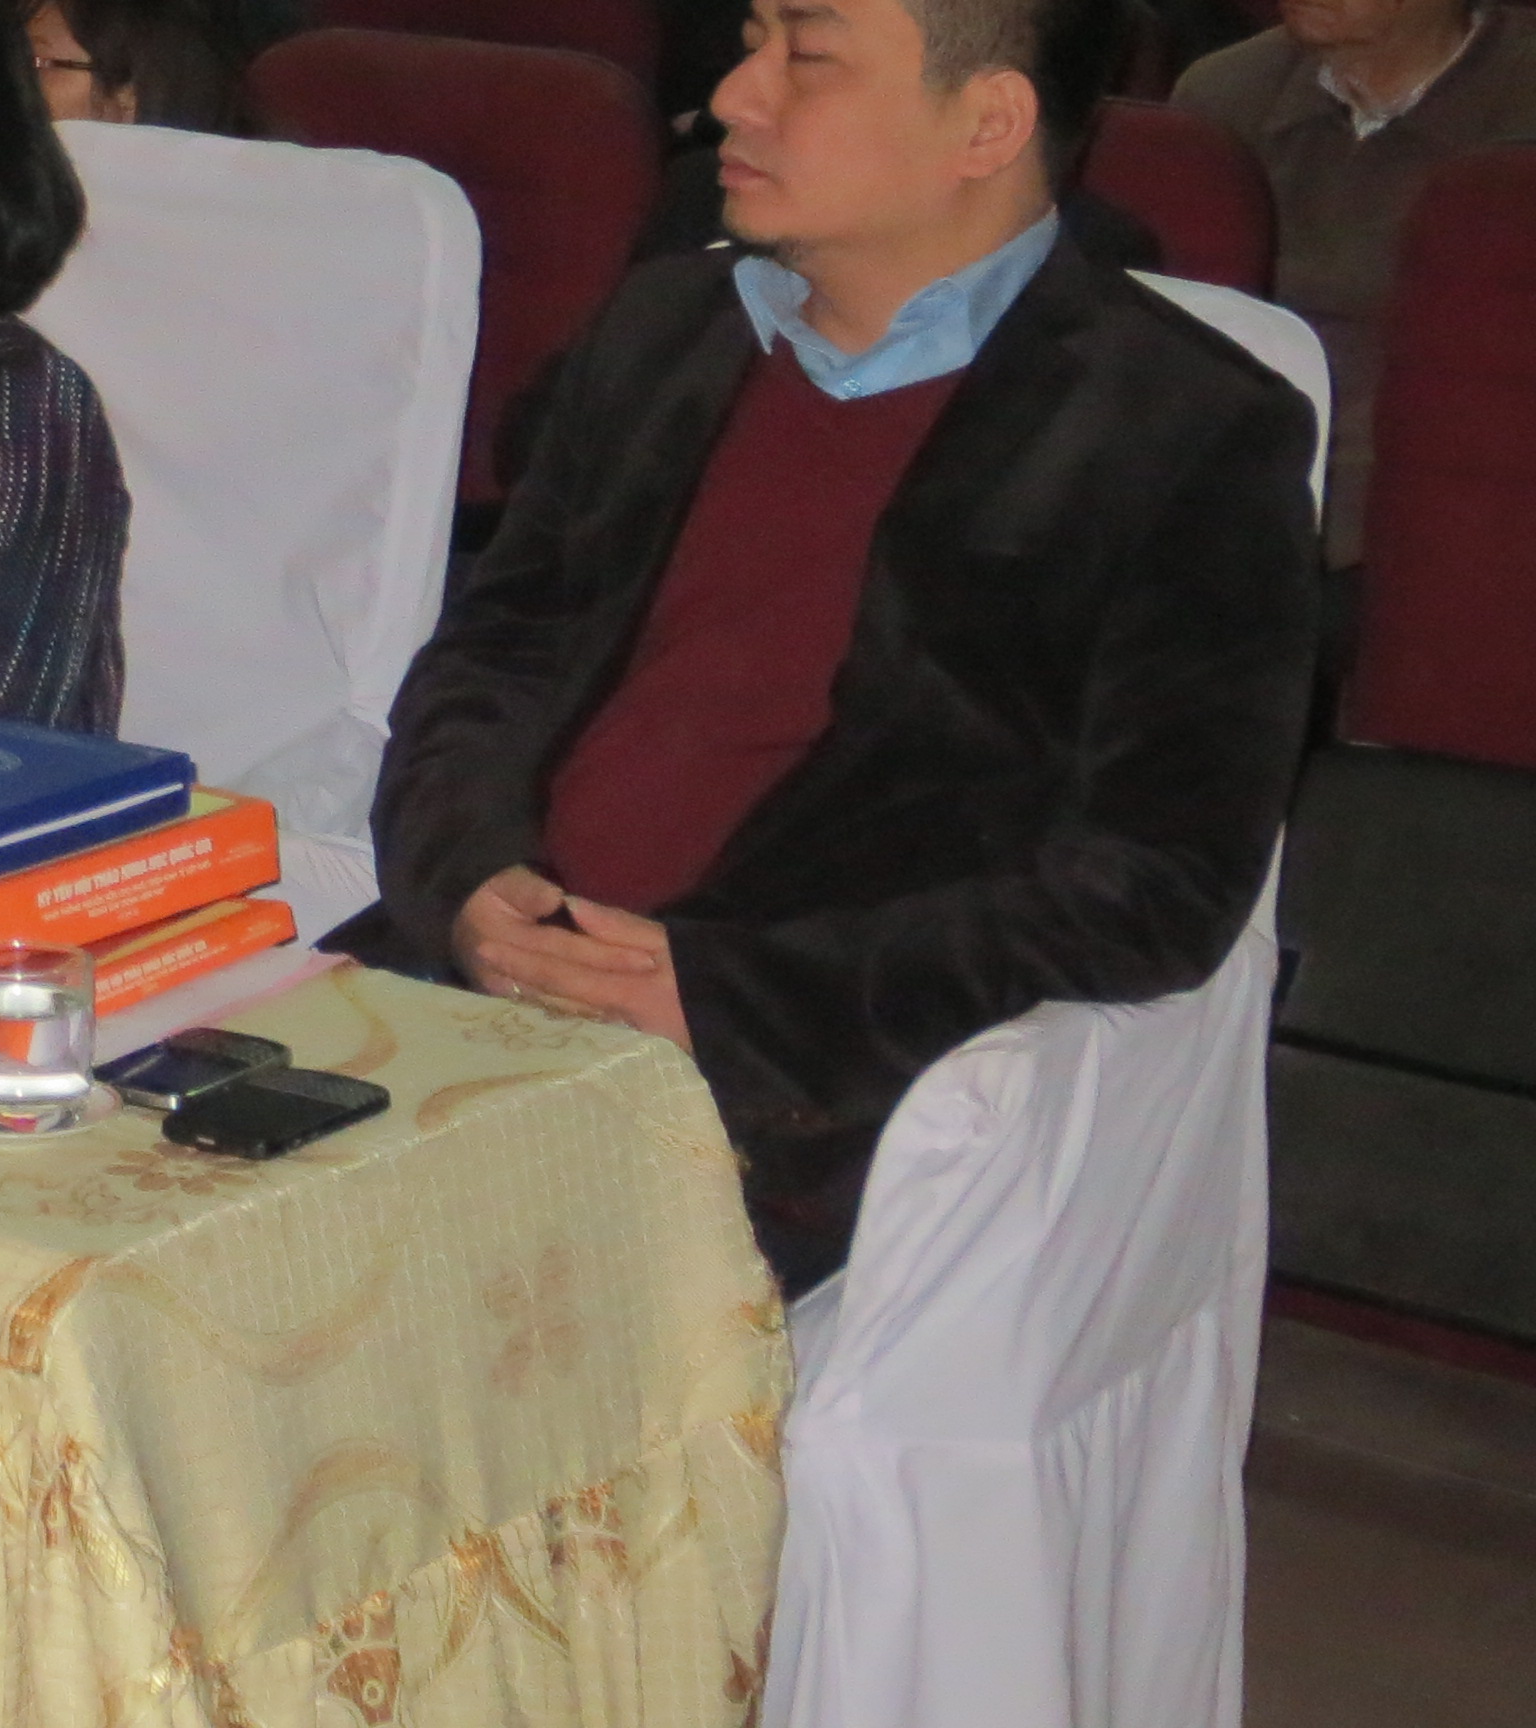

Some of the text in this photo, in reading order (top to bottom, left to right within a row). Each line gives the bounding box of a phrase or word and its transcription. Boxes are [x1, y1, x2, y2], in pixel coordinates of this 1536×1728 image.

[93, 867, 120, 889] THẢO
[120, 859, 147, 879] KHOA
[195, 836, 212, 855] GIA
